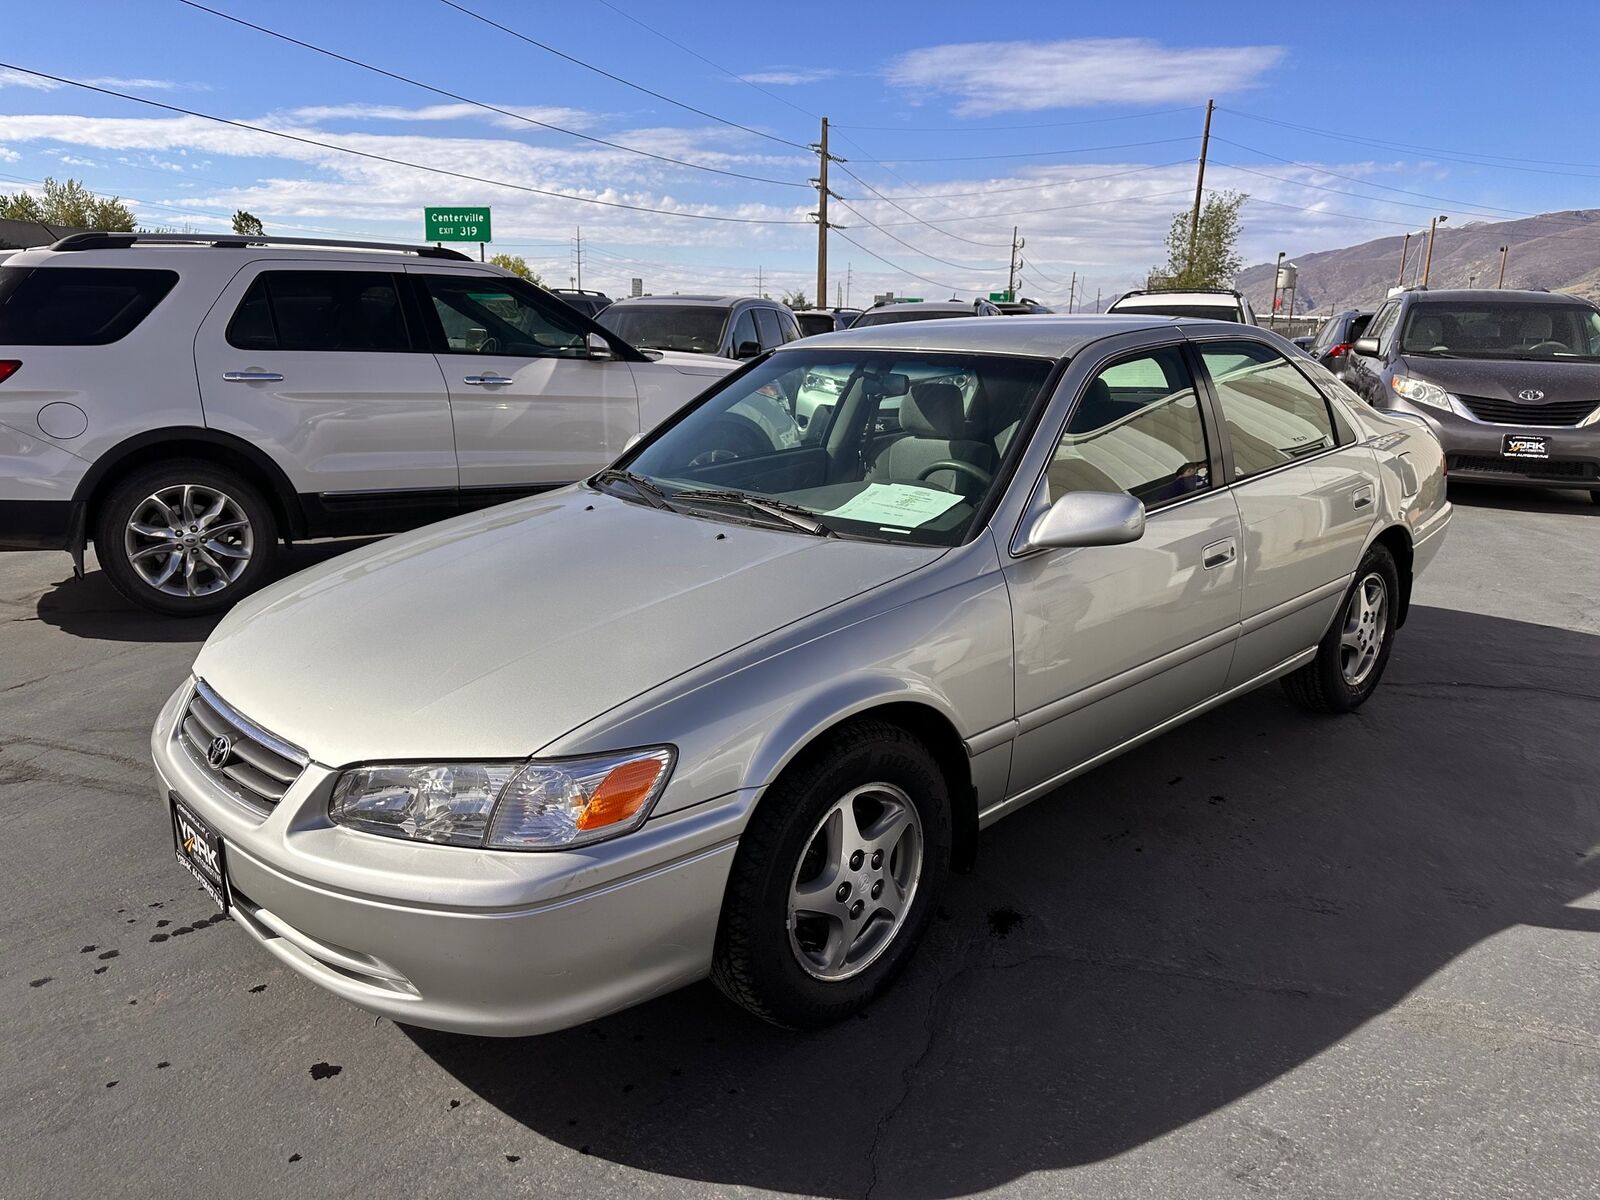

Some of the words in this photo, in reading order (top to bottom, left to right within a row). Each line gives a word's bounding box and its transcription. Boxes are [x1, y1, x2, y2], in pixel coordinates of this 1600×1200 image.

[432, 213, 484, 222] Centerville
[439, 227, 453, 235] EXIT
[460, 226, 477, 236] 319
[1508, 440, 1546, 450] YORK
[177, 814, 220, 874] YORK
